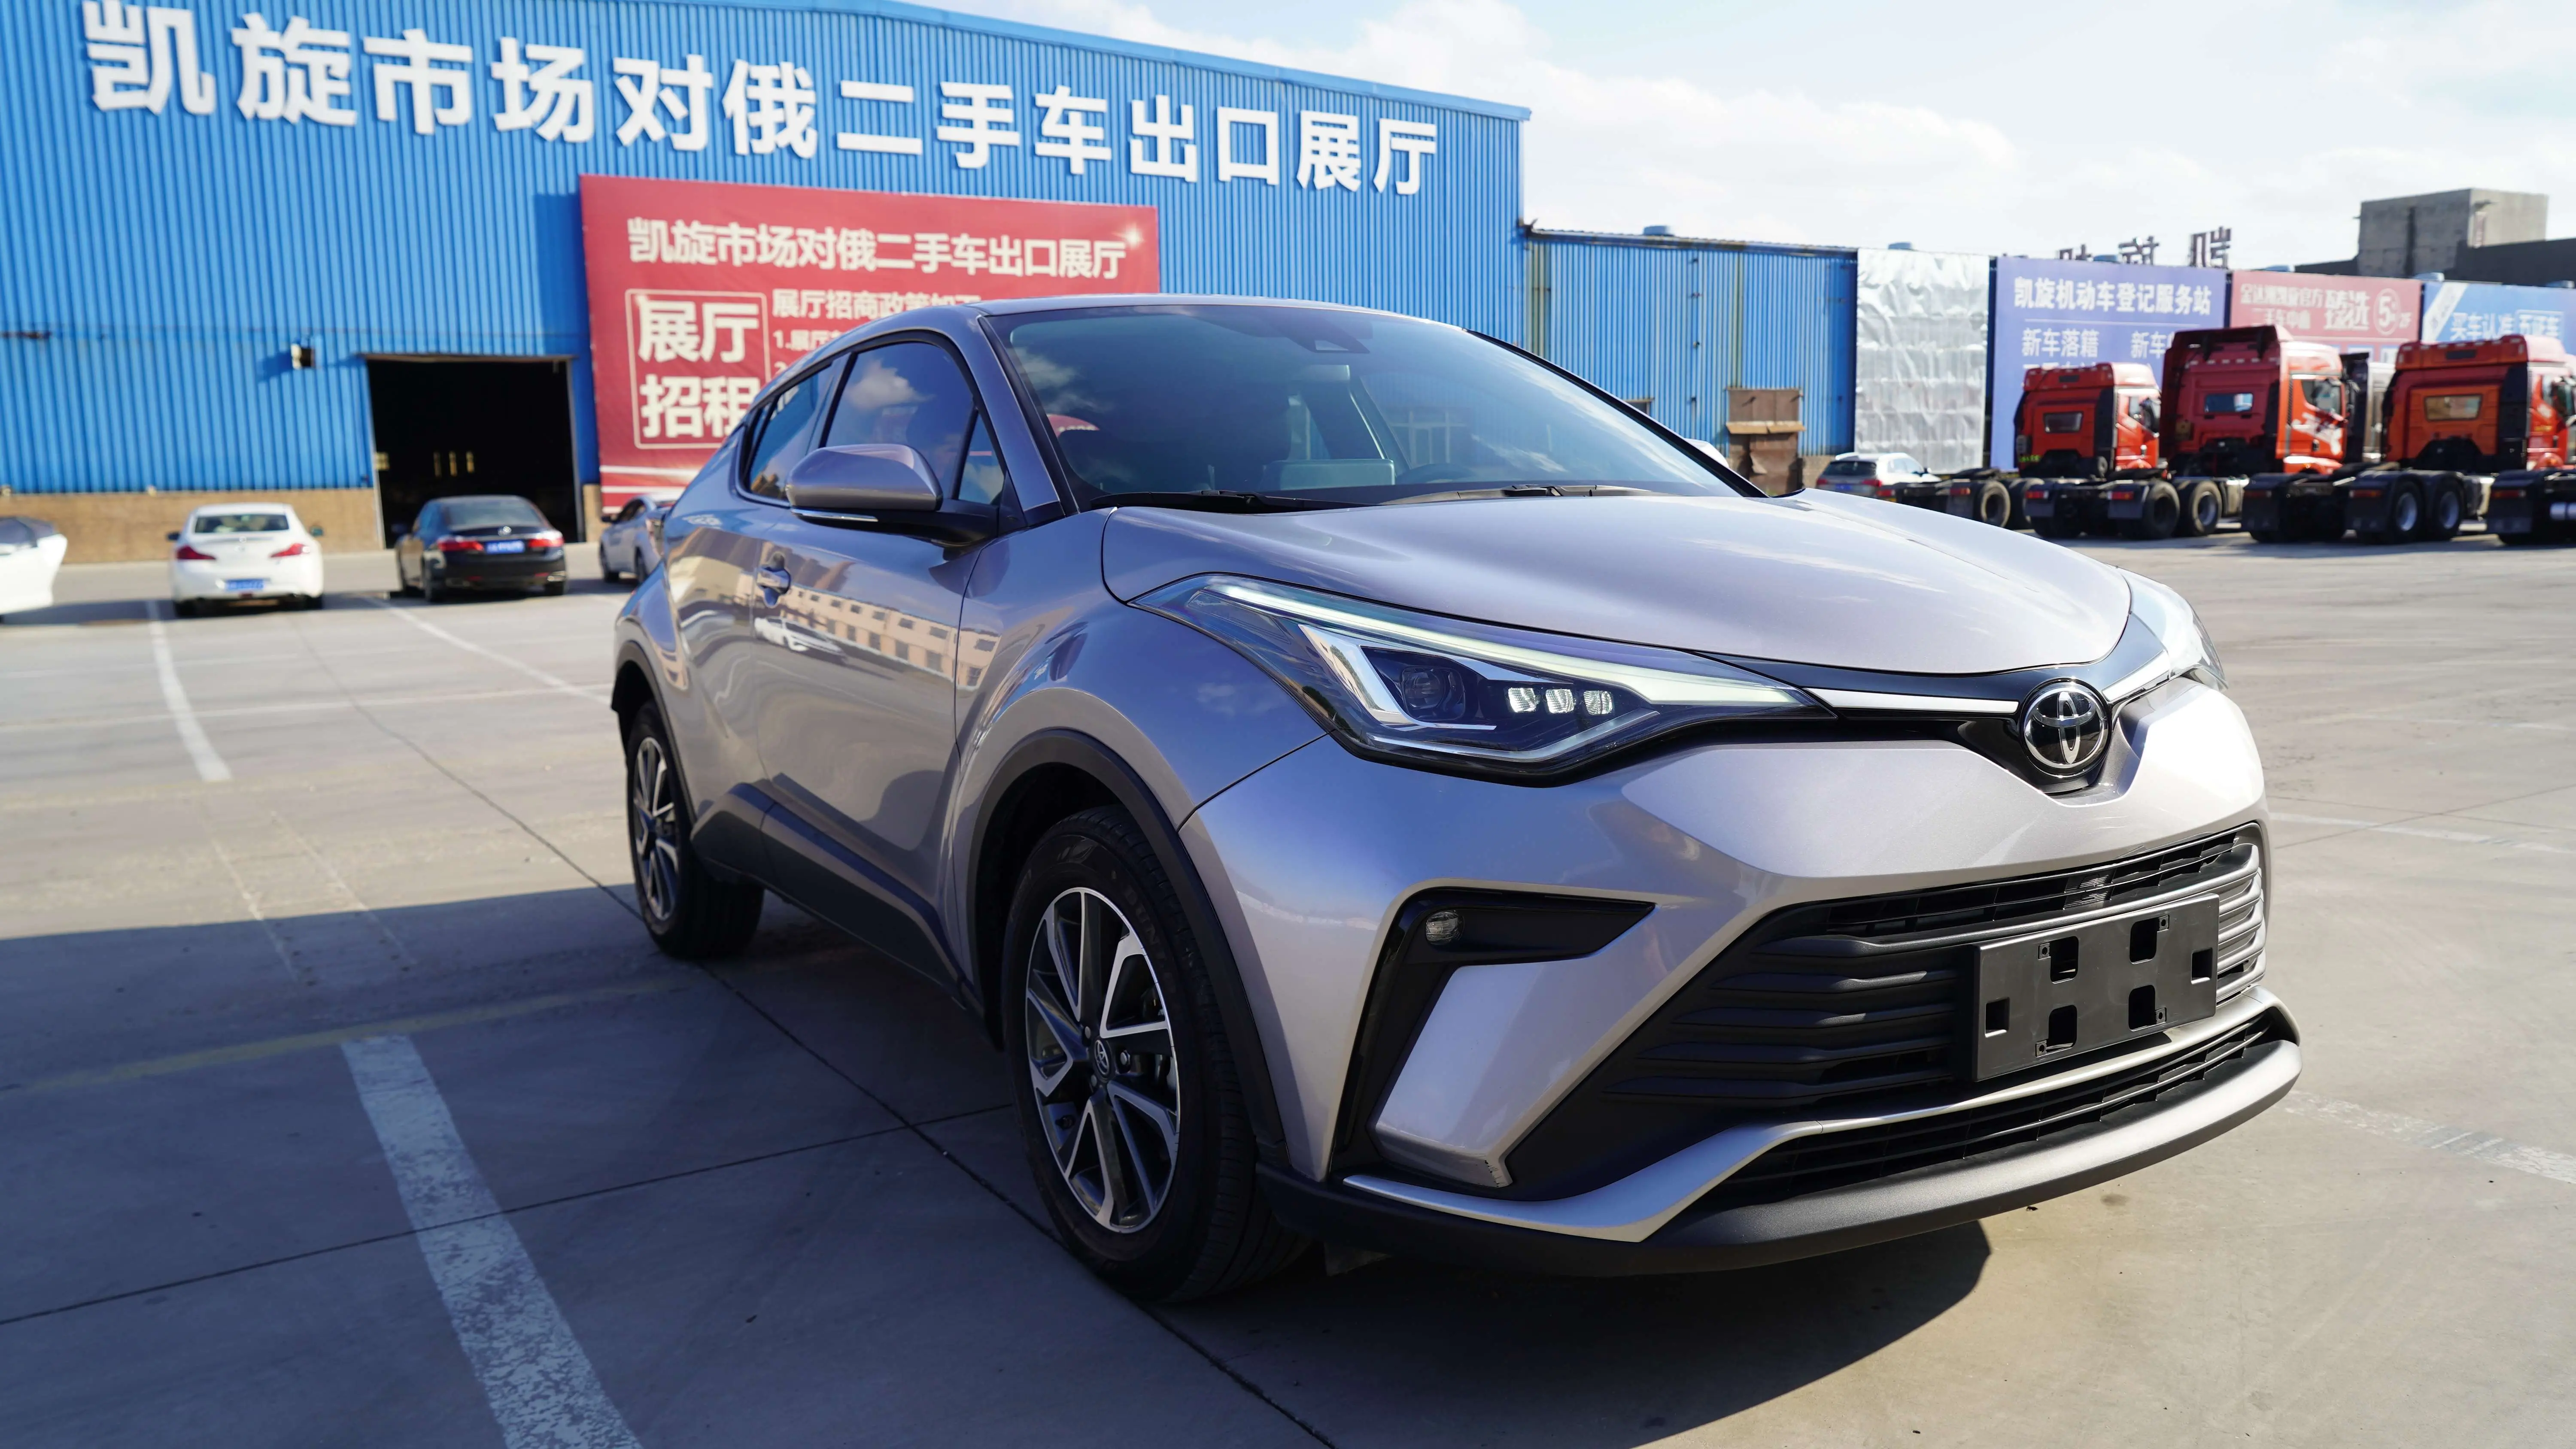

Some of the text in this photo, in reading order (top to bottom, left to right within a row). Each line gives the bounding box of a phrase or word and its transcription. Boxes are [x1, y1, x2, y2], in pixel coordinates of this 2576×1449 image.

[82, 1, 1437, 195] 凯旋市场对俄二手车出口展厅
[627, 217, 1126, 280] 凯旋市场对俄二手车出口展厅
[2014, 276, 2211, 315] 凯旋机动车登记服务站
[638, 299, 760, 362] 展厅
[2022, 328, 2099, 357] 新车落籍
[2130, 330, 2174, 358] 新车
[639, 374, 760, 438] 招租
